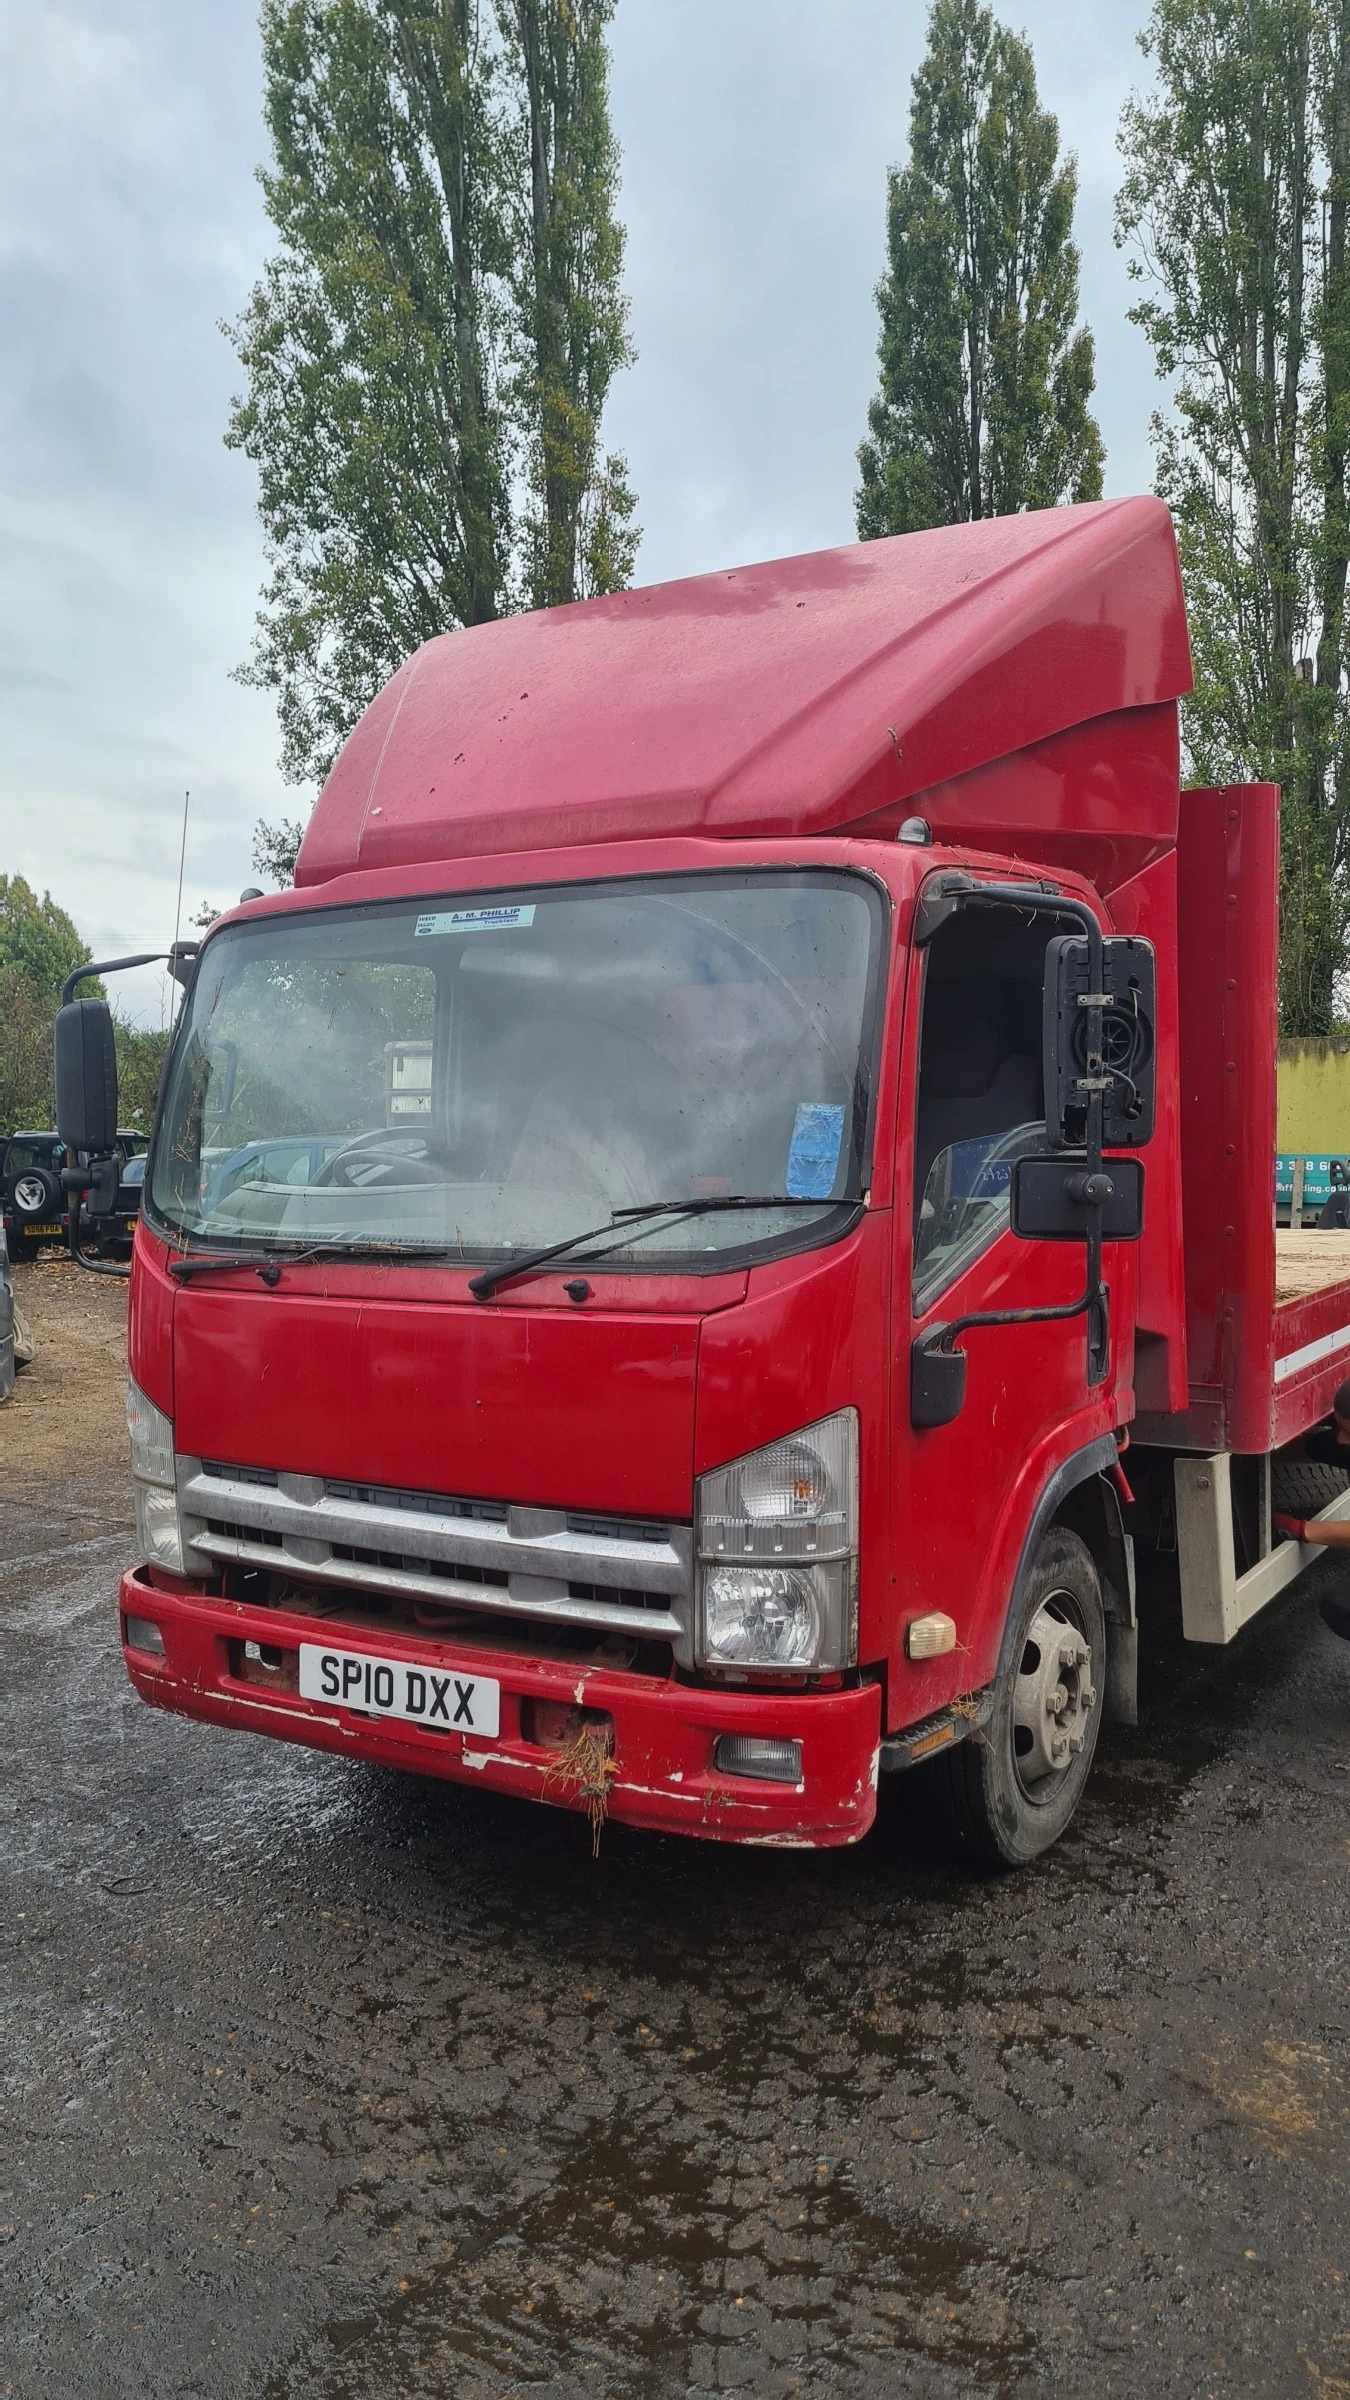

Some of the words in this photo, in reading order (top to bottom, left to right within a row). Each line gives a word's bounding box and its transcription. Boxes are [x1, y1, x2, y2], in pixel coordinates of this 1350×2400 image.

[480, 908, 521, 917] PHILLIP
[321, 1655, 394, 1708] SP10
[406, 1671, 475, 1725] DXX
